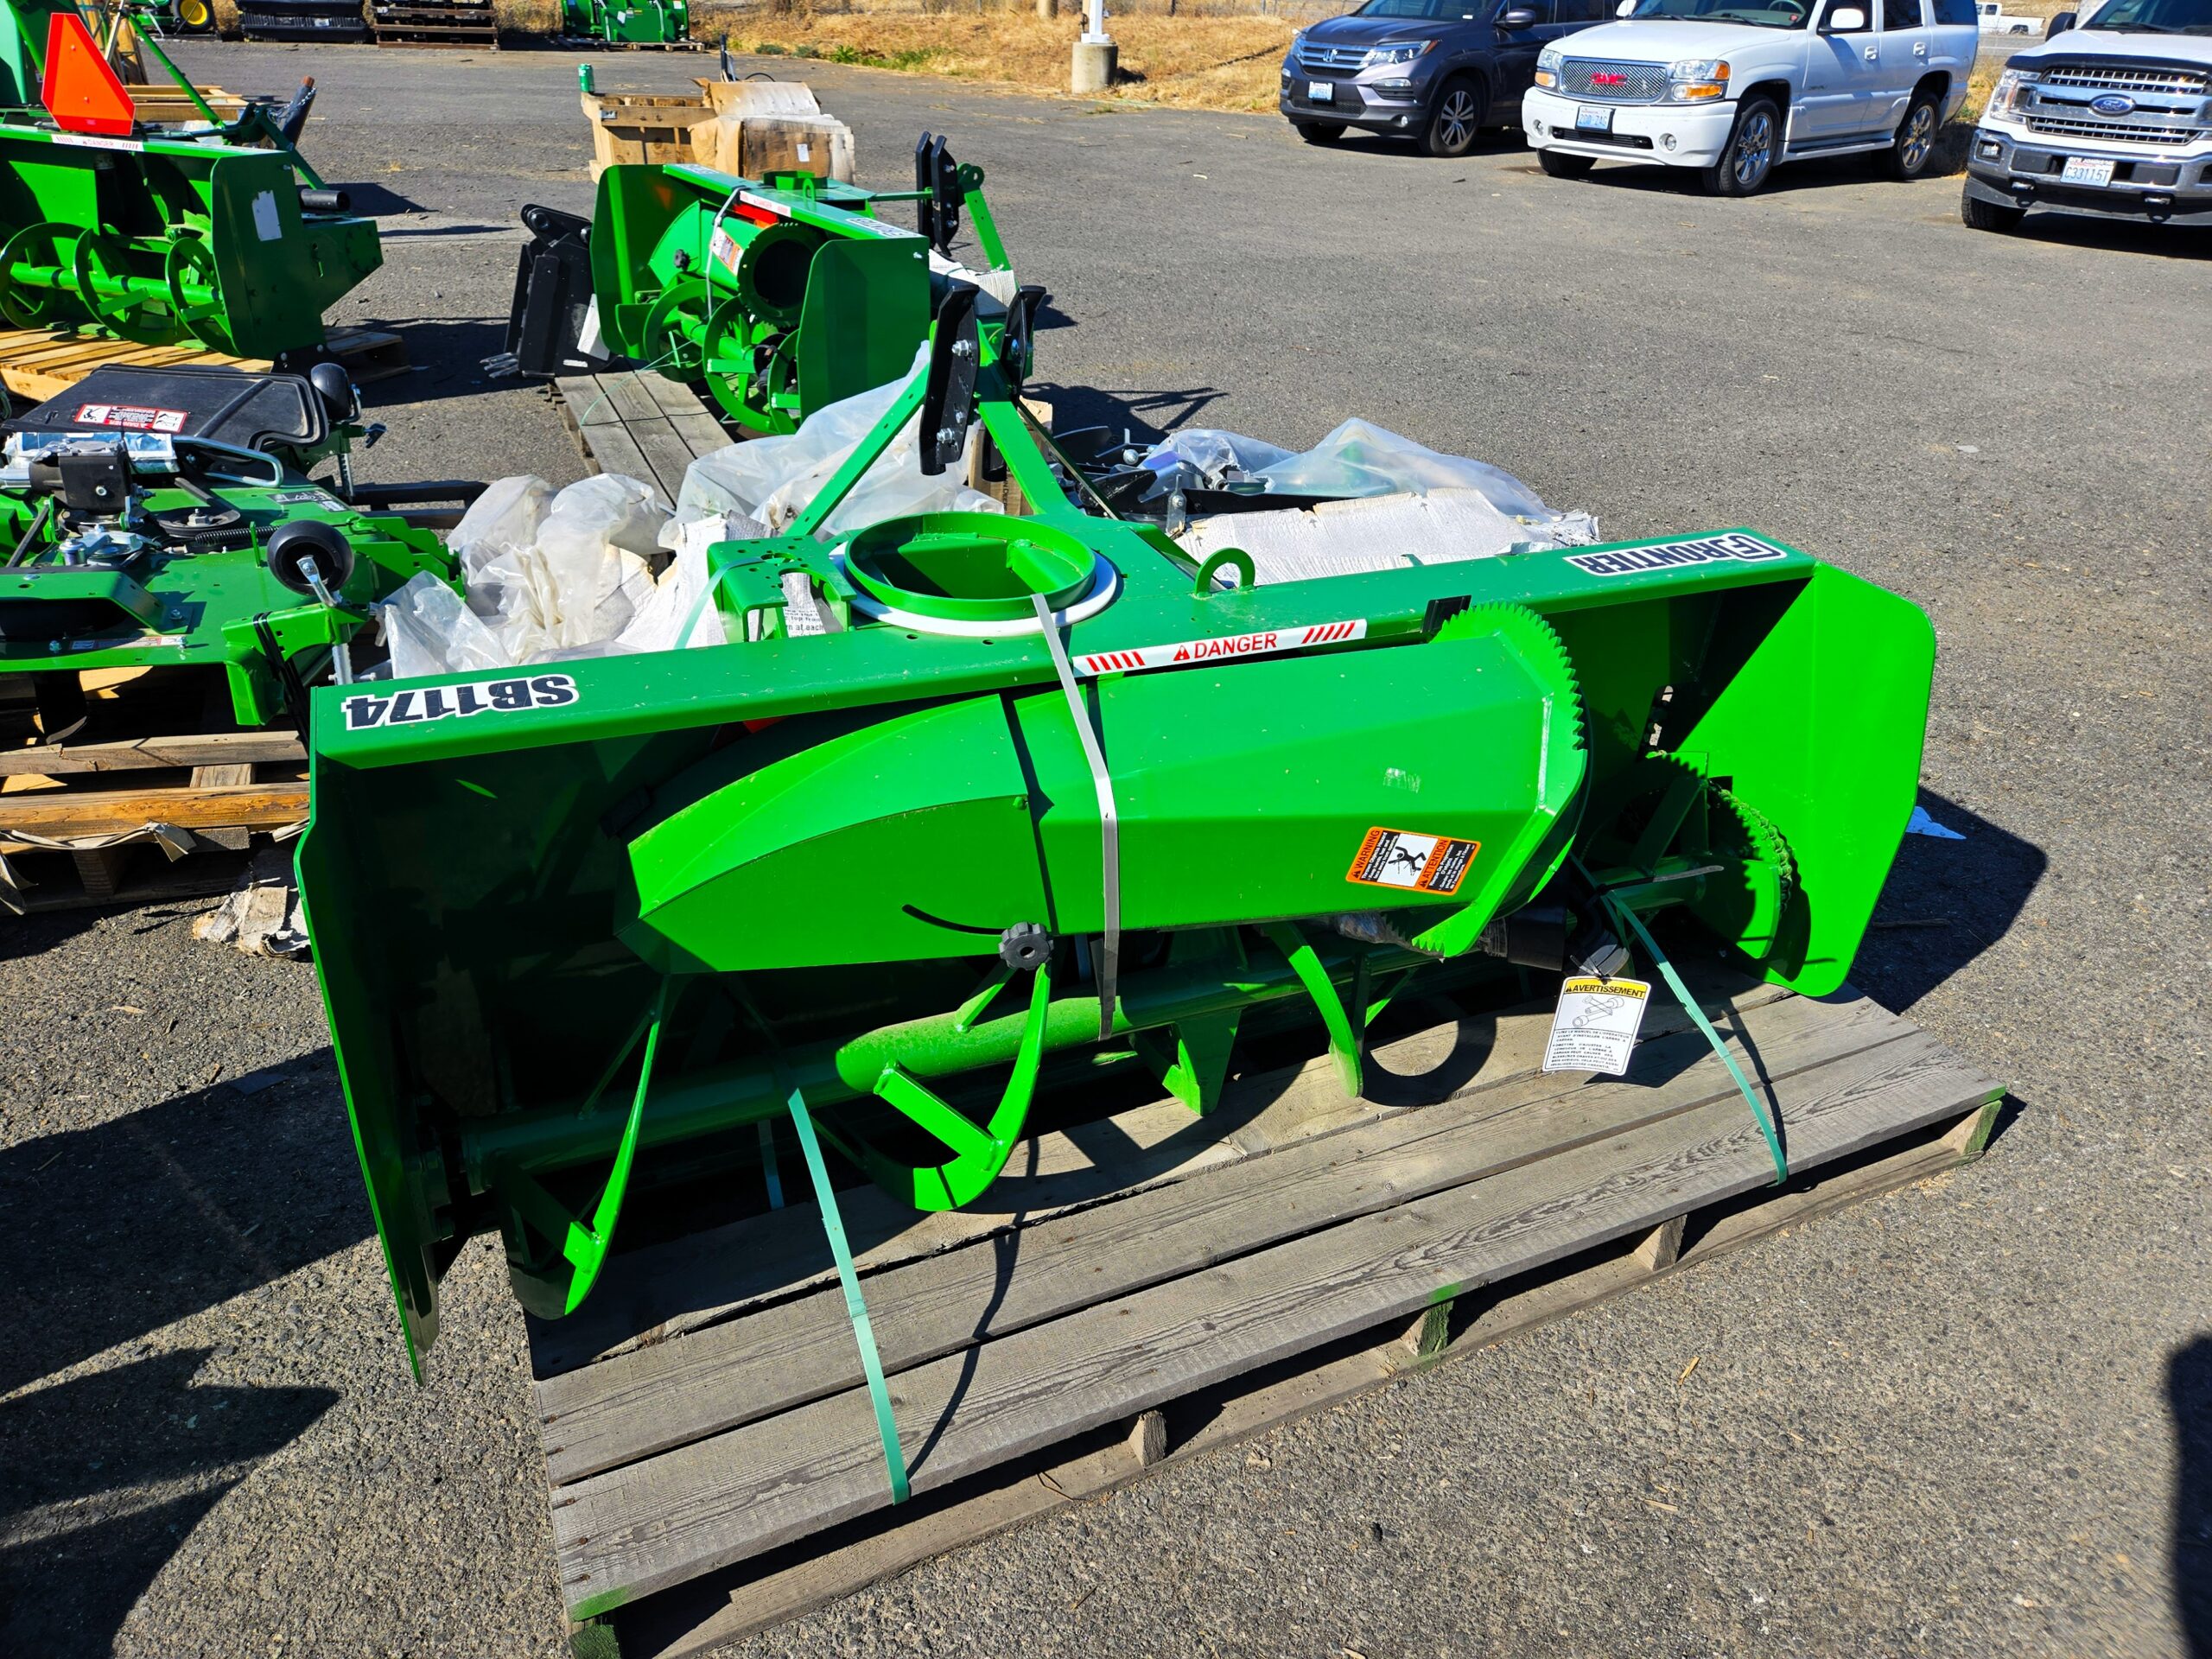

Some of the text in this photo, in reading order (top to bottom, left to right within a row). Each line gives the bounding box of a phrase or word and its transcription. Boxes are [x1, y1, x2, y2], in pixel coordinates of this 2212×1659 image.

[1591, 72, 1628, 86] GMC
[1569, 534, 1784, 575] FRONTIER
[1194, 633, 1278, 659] DANGER
[346, 675, 575, 728] SB1174
[1356, 830, 1380, 868] WARNING
[1424, 839, 1449, 879] ATTENTION
[1573, 984, 1645, 998] AVERTISSEMENT
